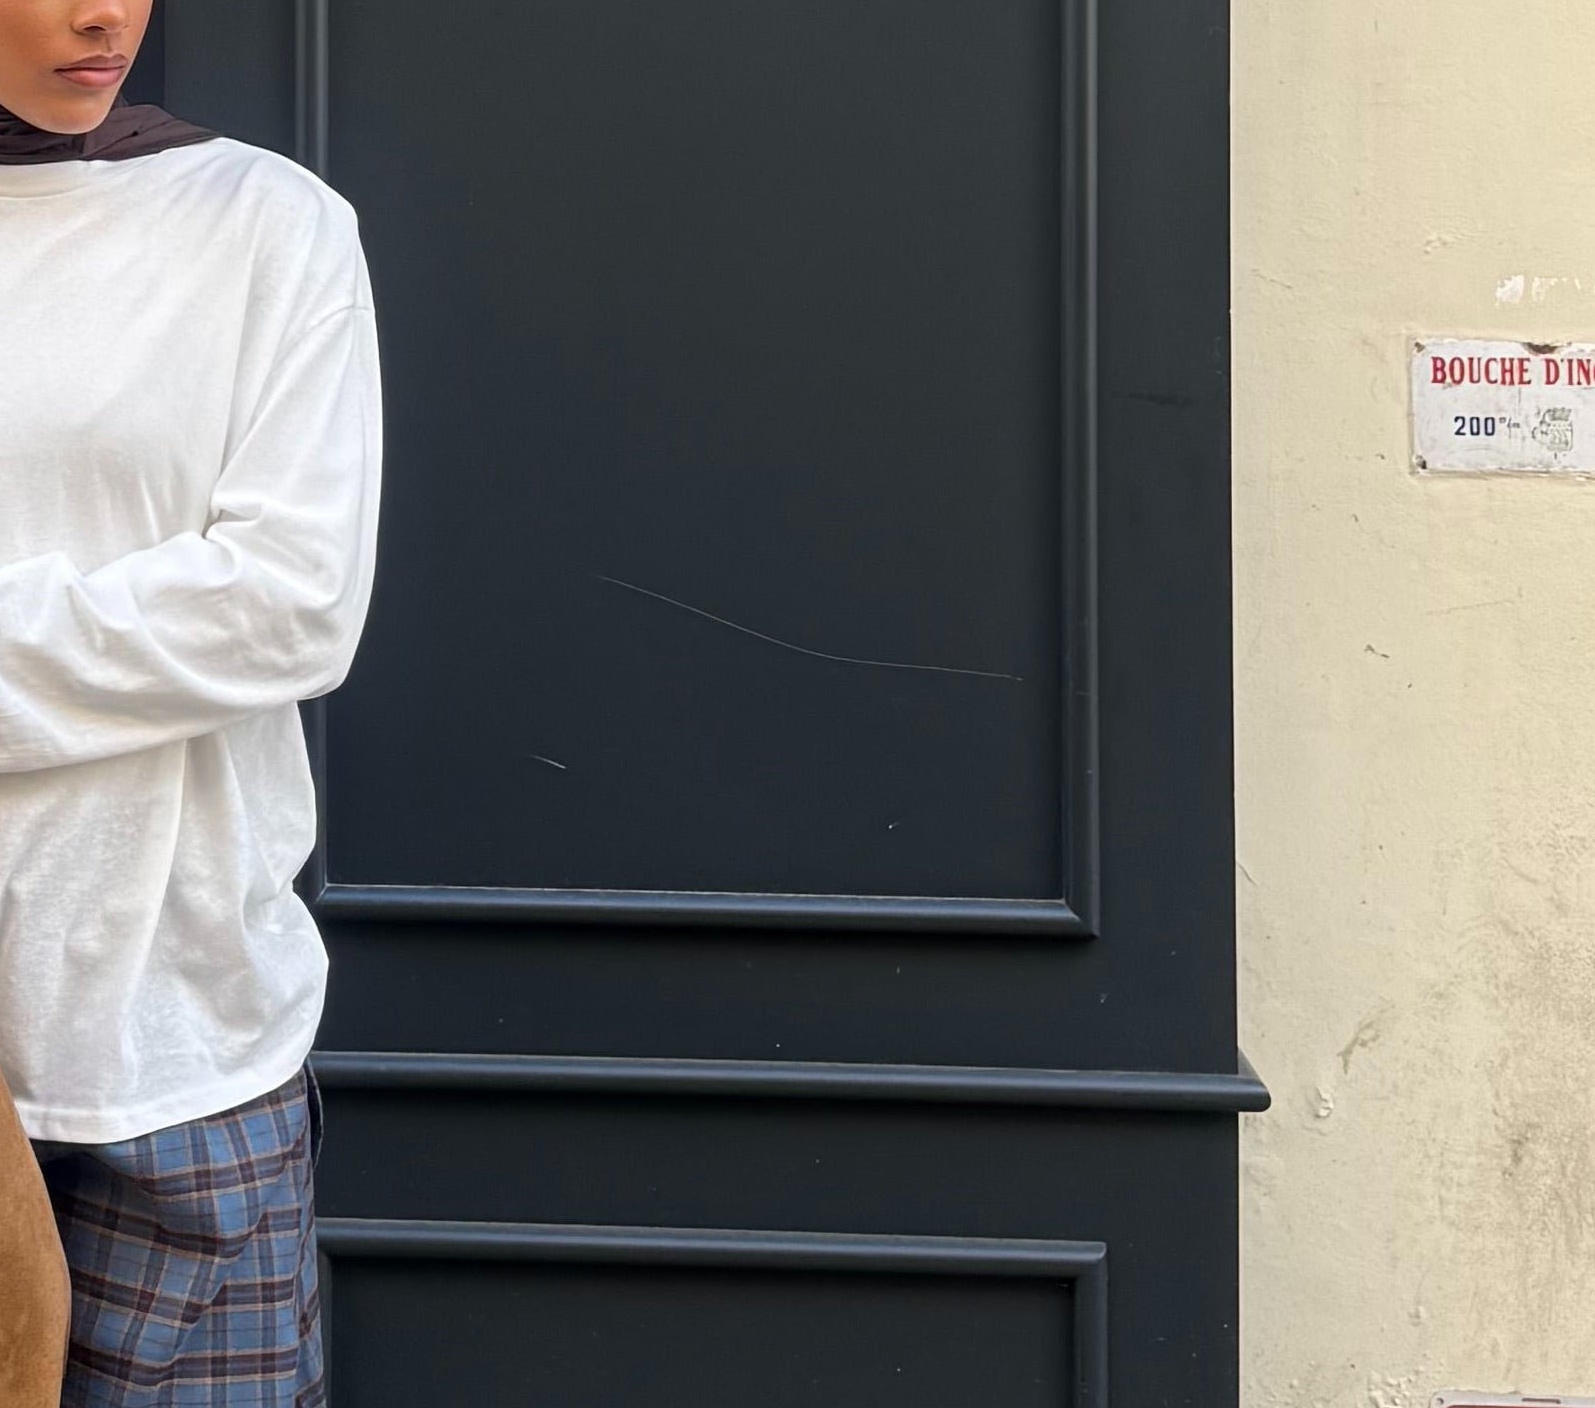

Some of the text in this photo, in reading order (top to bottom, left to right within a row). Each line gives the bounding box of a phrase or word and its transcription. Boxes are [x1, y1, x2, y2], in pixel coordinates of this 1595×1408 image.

[1431, 356, 1595, 386] BOUCHE D'IN
[1453, 415, 1496, 437] 200
